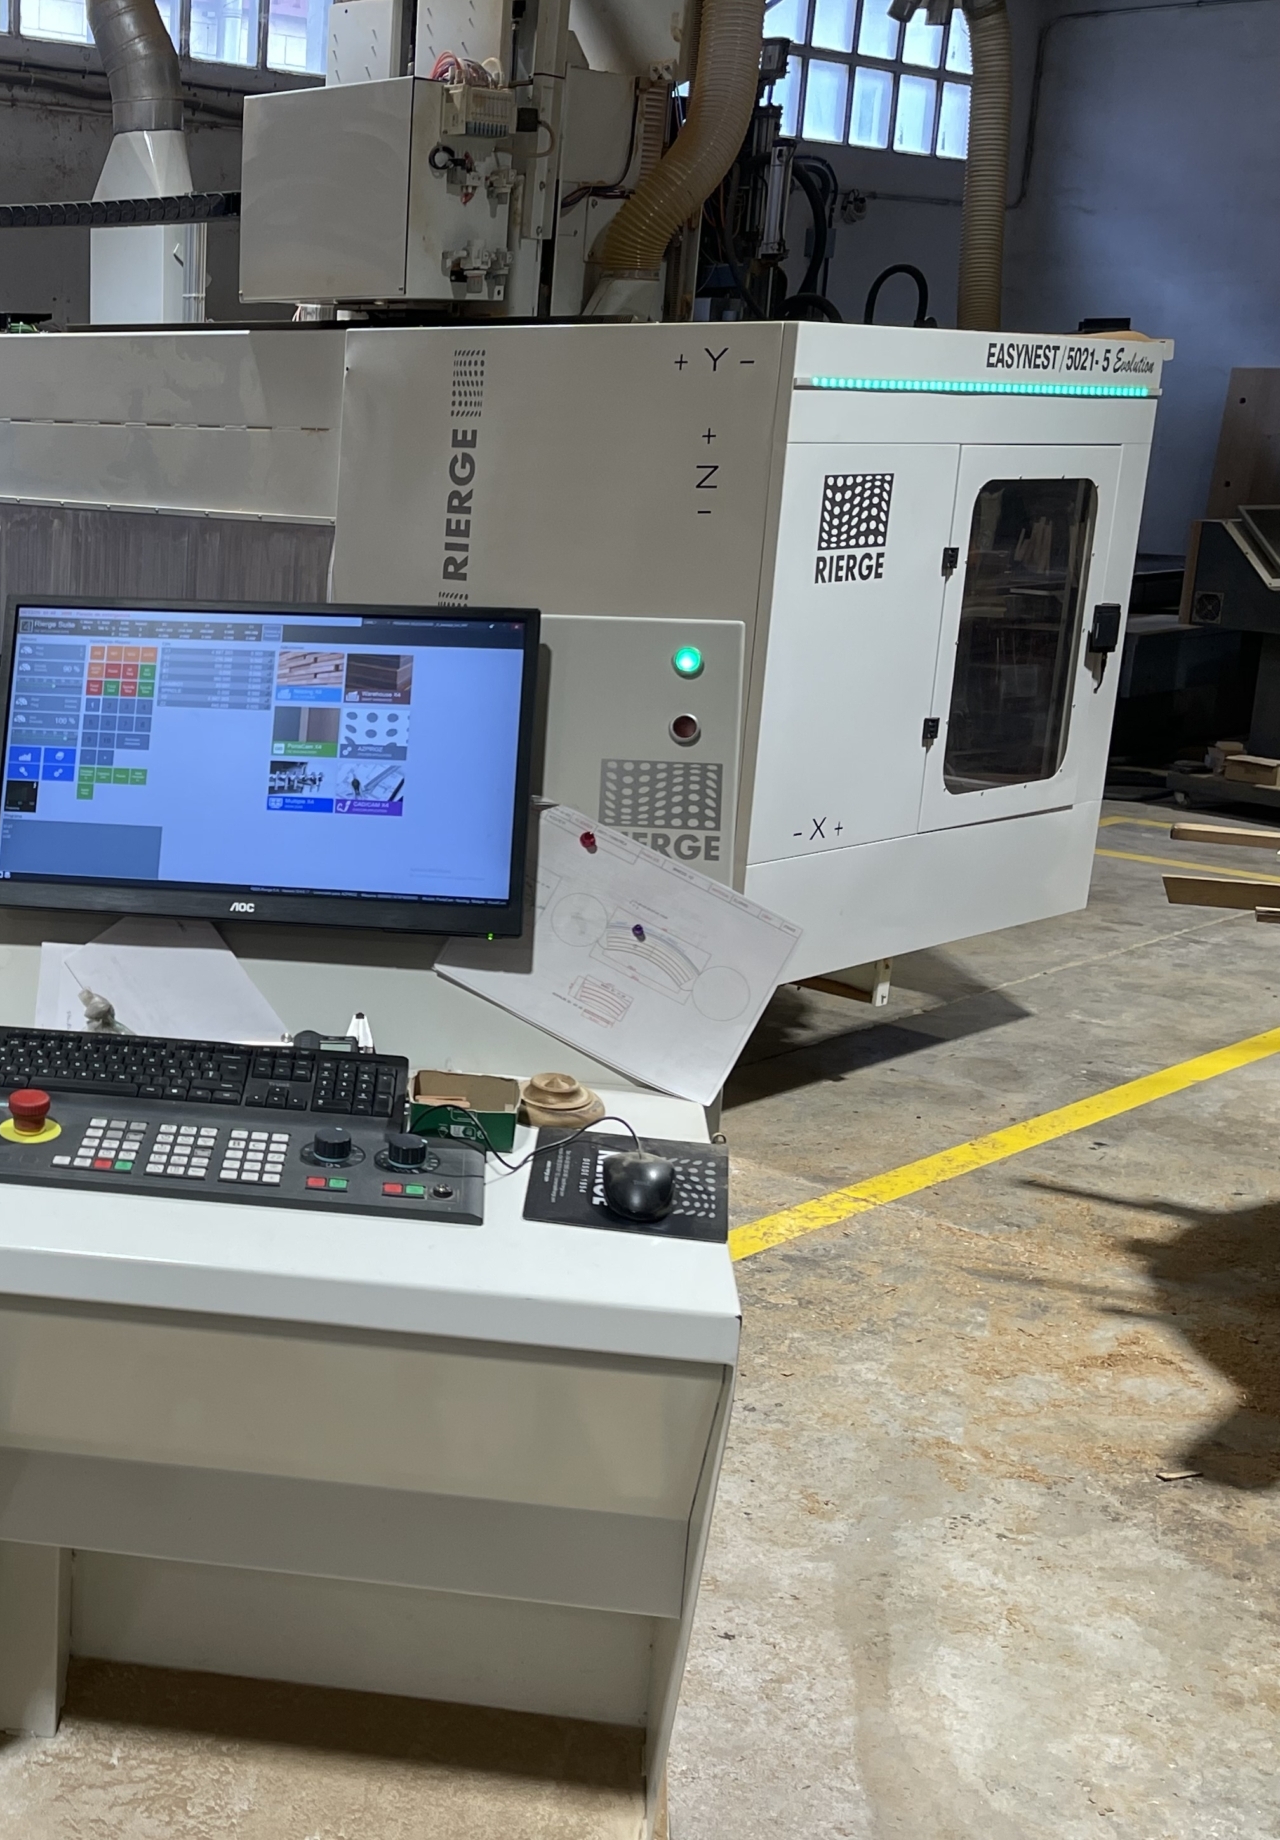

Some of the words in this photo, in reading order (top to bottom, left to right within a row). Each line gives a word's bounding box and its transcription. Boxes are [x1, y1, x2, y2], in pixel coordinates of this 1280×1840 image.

[704, 347, 729, 372] Y
[1113, 347, 1155, 374] Evolution
[695, 465, 719, 489] Z
[442, 428, 478, 582] RIERGE
[814, 551, 885, 584] RIERGE
[34, 620, 56, 629] Rierge
[58, 620, 75, 628] Suite
[55, 716, 68, 725] 100
[809, 817, 827, 840] X
[229, 902, 255, 913] AOC
